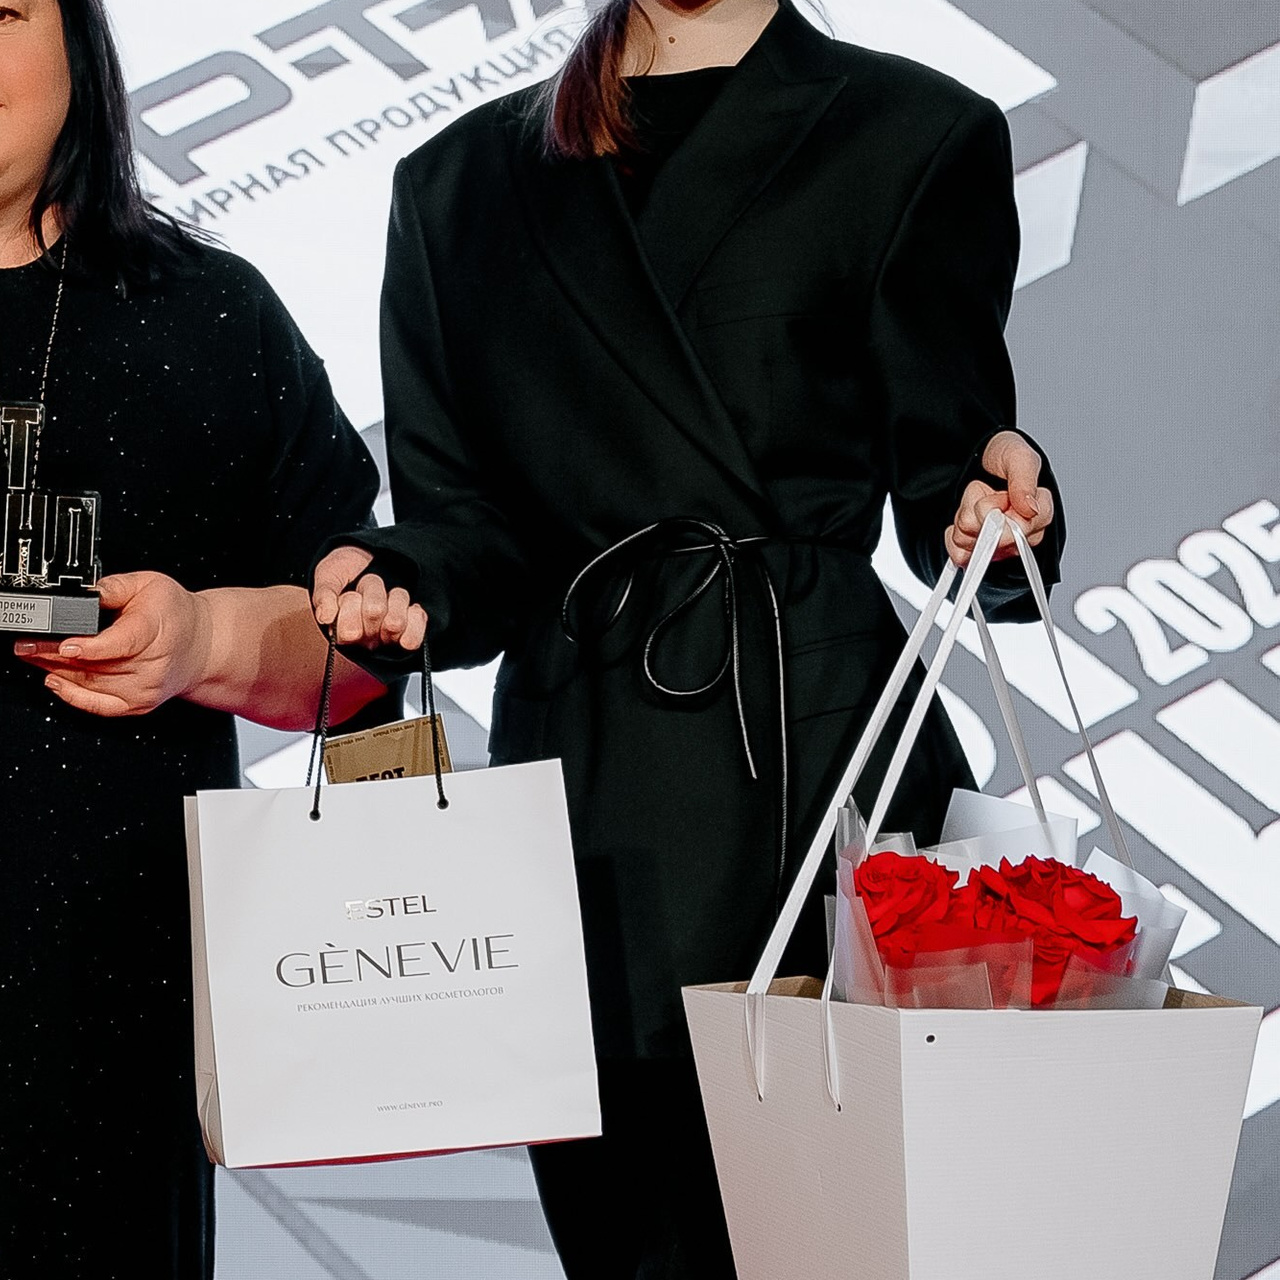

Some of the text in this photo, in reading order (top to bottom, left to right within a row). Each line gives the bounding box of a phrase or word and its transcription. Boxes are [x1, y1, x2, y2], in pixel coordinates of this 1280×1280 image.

[176, 28, 577, 225] ИРНАЯ ПРОДУКЦИЯ
[2, 612, 33, 624] 2025»
[275, 934, 519, 989] GÈNEVIE
[297, 986, 504, 1012] РЕКОМЕНДАЦИЯ ЛУЧШИХ КОСМЕТОЛОГОВ
